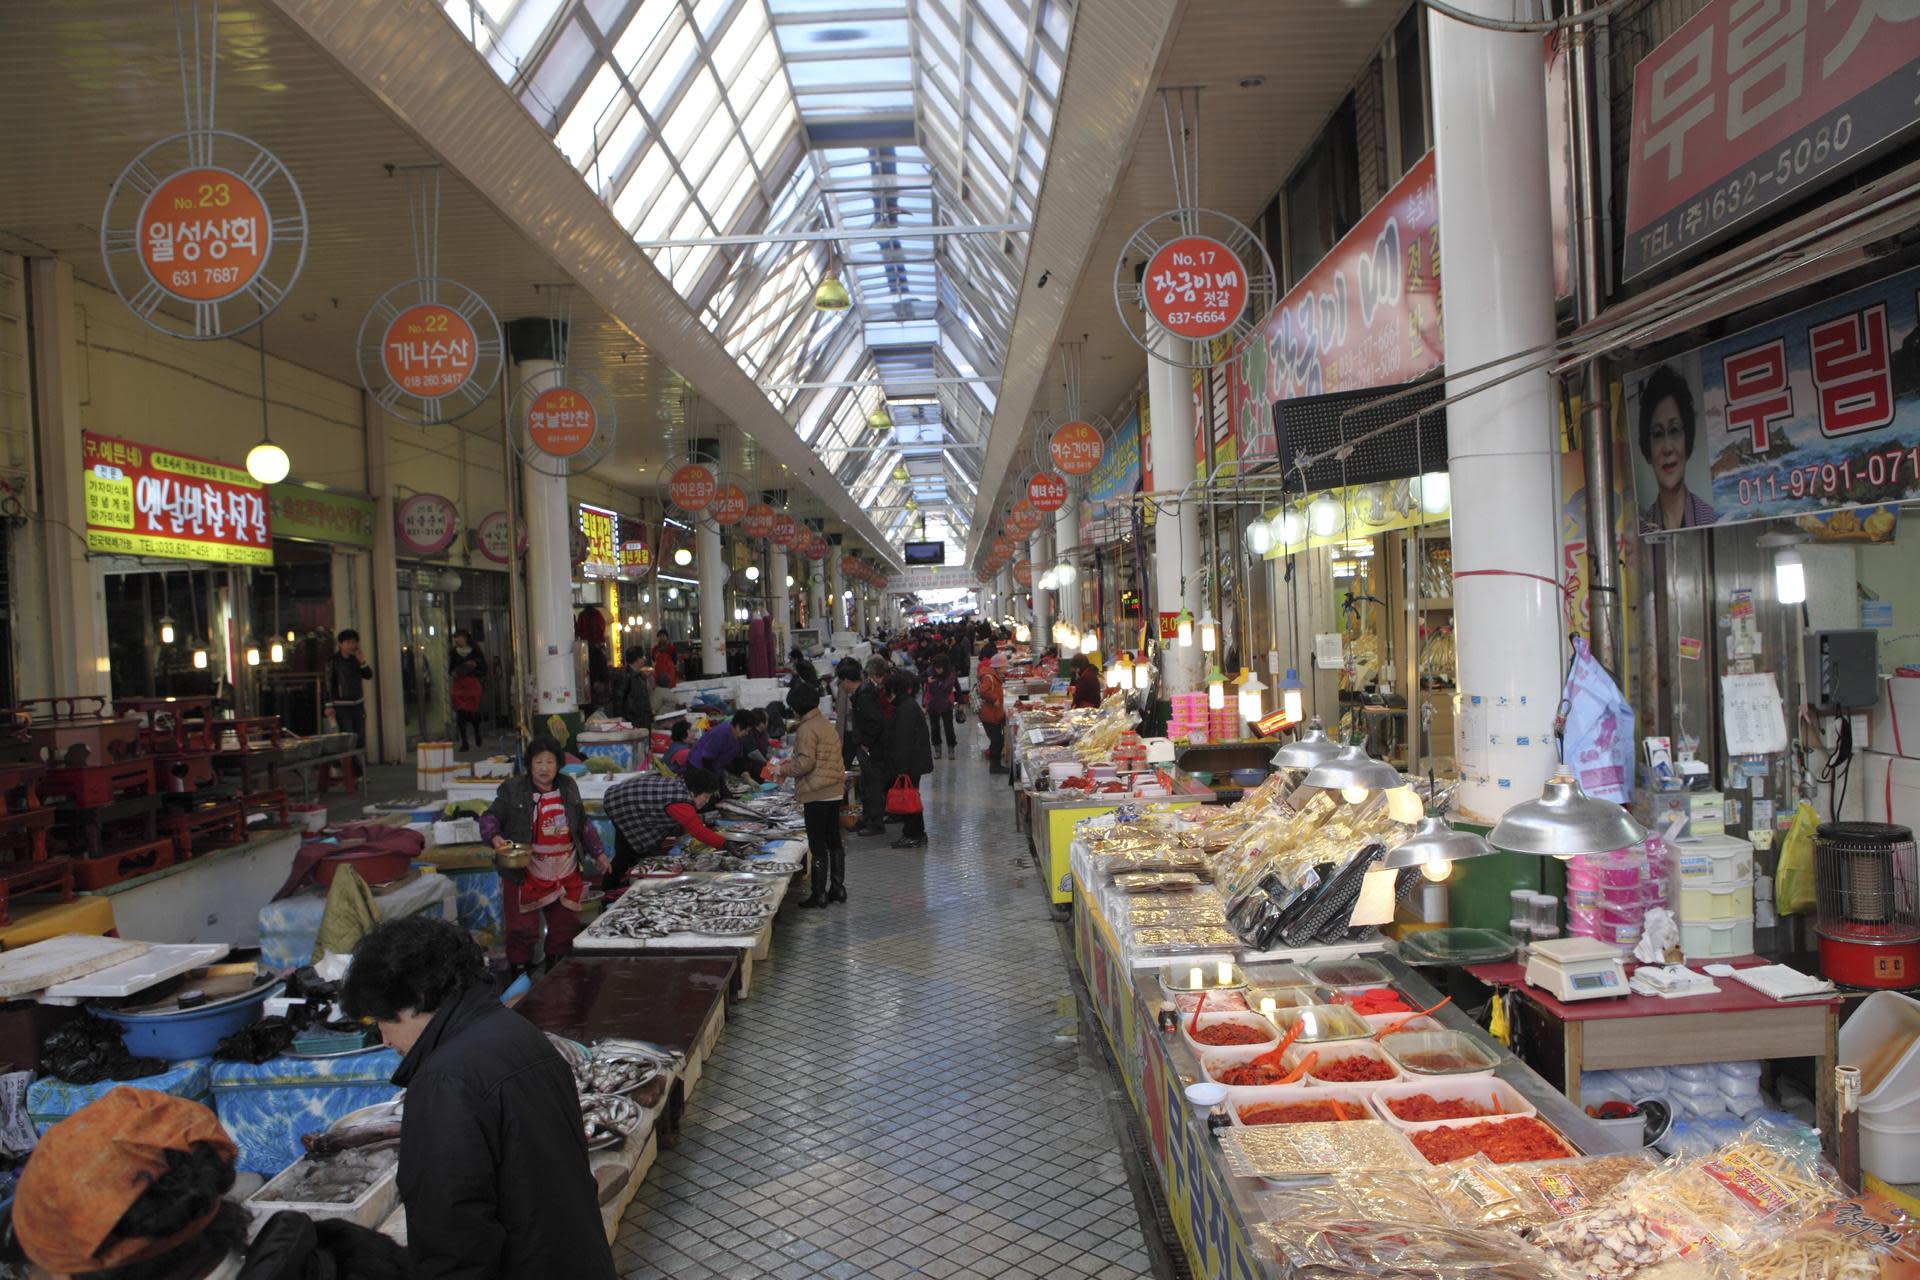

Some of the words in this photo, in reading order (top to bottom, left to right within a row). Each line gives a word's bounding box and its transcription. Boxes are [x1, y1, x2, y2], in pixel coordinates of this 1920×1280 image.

[149, 217, 257, 263] 월성상회
[1200, 251, 1216, 265] 17
[172, 270, 198, 287] 631
[204, 267, 240, 283] 7687
[1204, 291, 1230, 307] 젓갈
[1168, 311, 1226, 325] 637-6664
[390, 338, 469, 370] 가나수산
[1722, 300, 1896, 454] 무림
[530, 410, 589, 429] 옛날반찬
[1052, 442, 1100, 458] 여수건어물
